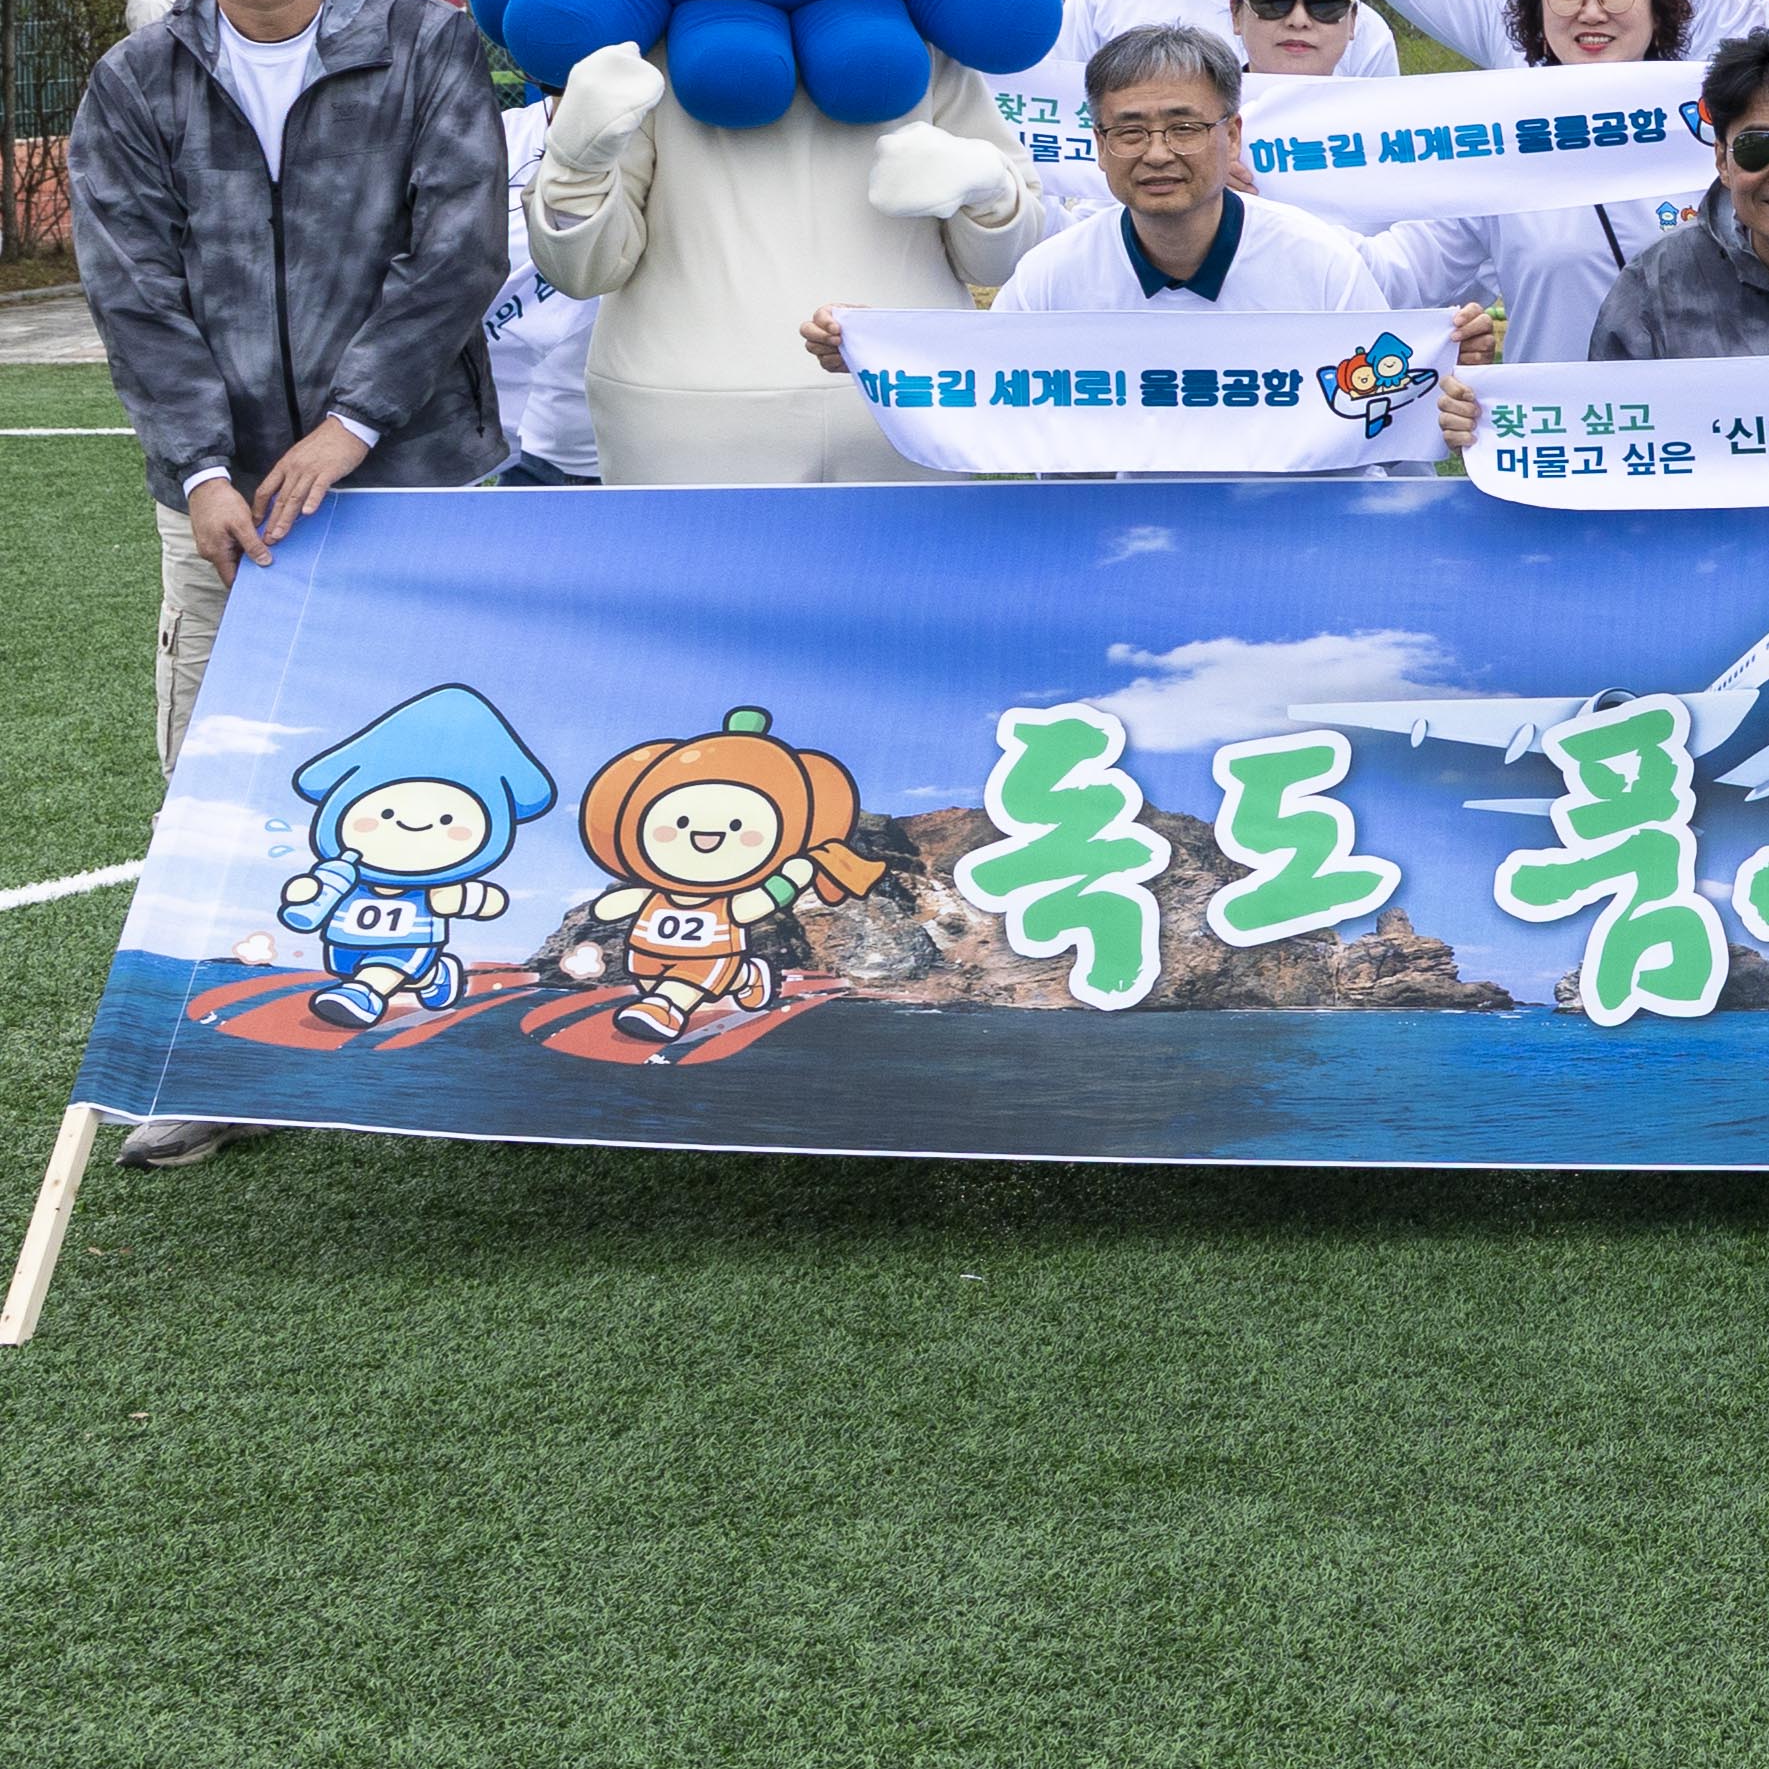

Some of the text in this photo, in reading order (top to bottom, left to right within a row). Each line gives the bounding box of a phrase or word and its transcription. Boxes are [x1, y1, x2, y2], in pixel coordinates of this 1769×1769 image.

[996, 93, 1061, 125] 찾고
[1249, 107, 1669, 175] 하늘길 세계로! 울릉공항
[989, 369, 1128, 409] 세계로!
[1140, 369, 1305, 409] 울릉공항
[1492, 403, 1656, 440] 찾고 싶고
[1497, 442, 1697, 480] 머물고 싶은
[960, 704, 1398, 1008] 독도
[354, 905, 404, 933] 01
[656, 912, 703, 944] 02
